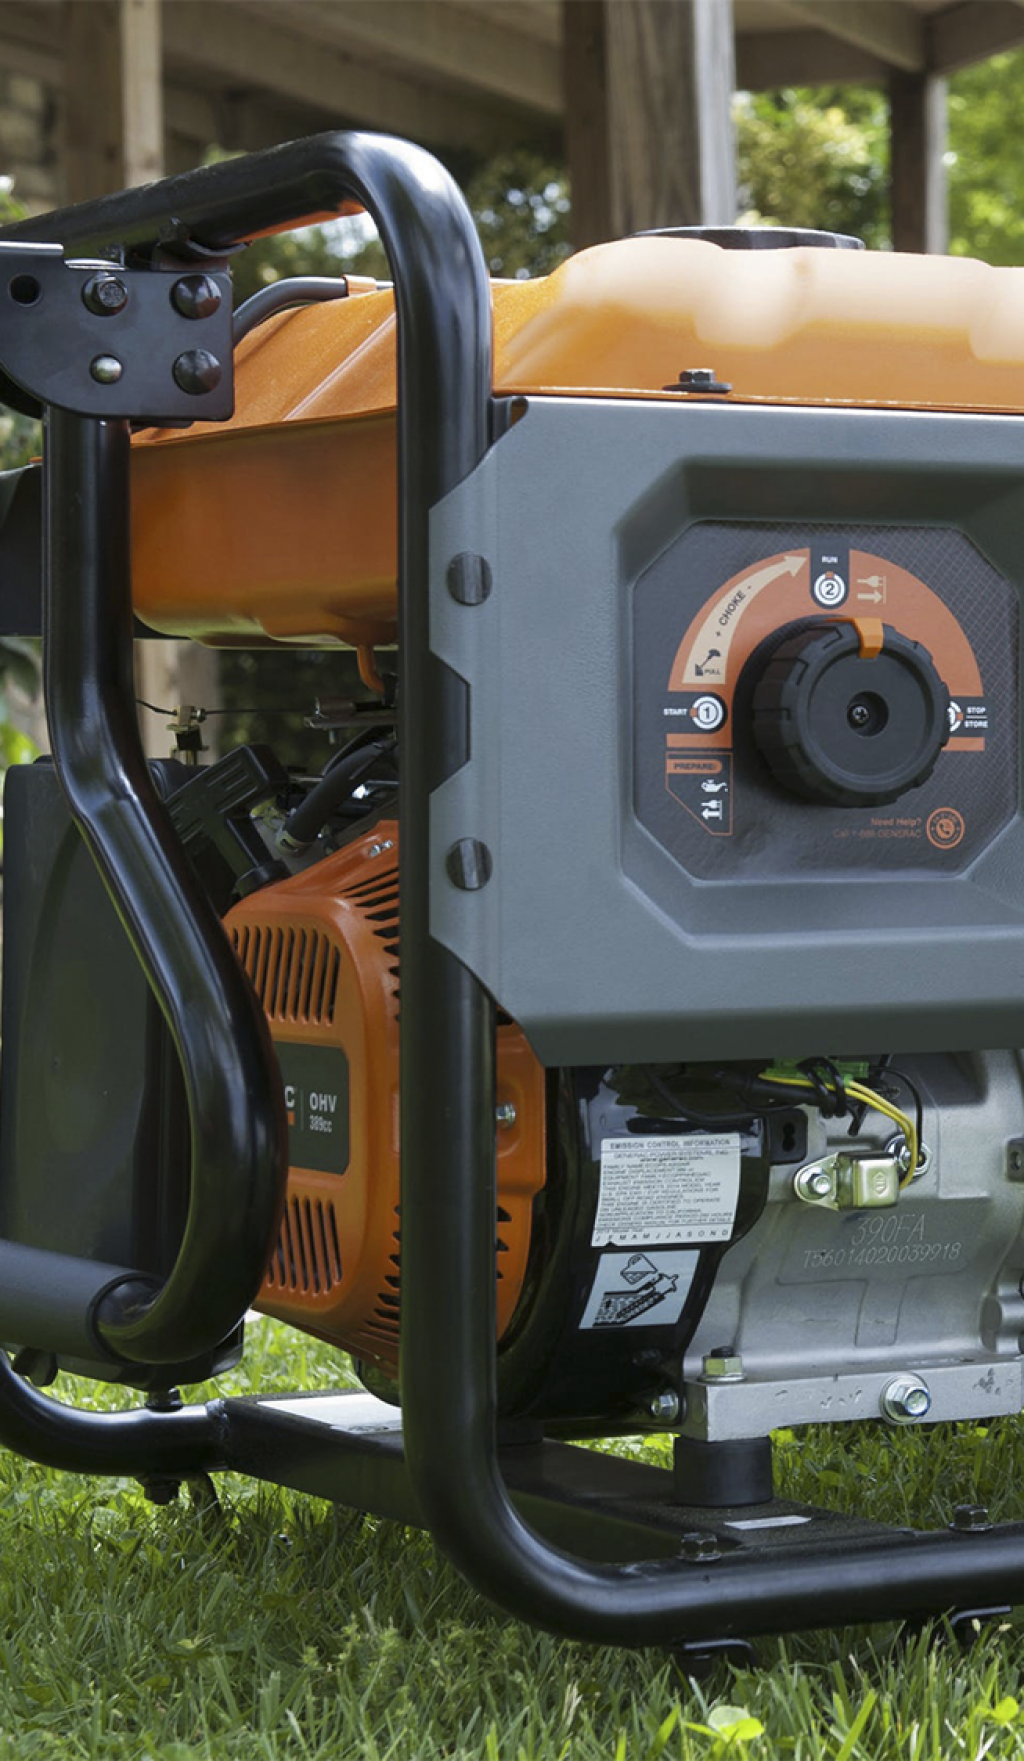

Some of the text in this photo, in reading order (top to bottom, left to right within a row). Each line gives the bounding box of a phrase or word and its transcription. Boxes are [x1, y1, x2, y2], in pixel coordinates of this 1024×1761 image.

[821, 556, 838, 564] RUN
[825, 582, 835, 596] 2
[718, 589, 746, 627] CHOKE
[704, 668, 721, 676] PULL
[663, 708, 688, 716] START
[966, 706, 987, 715] STOP
[964, 720, 989, 729] STORE
[870, 817, 922, 828] Need Help?
[309, 1092, 338, 1113] OHV
[309, 1115, 333, 1133] 389cc
[610, 1138, 730, 1150] EMISSION CONTROL INFORMATION
[851, 1213, 926, 1246] 390FA
